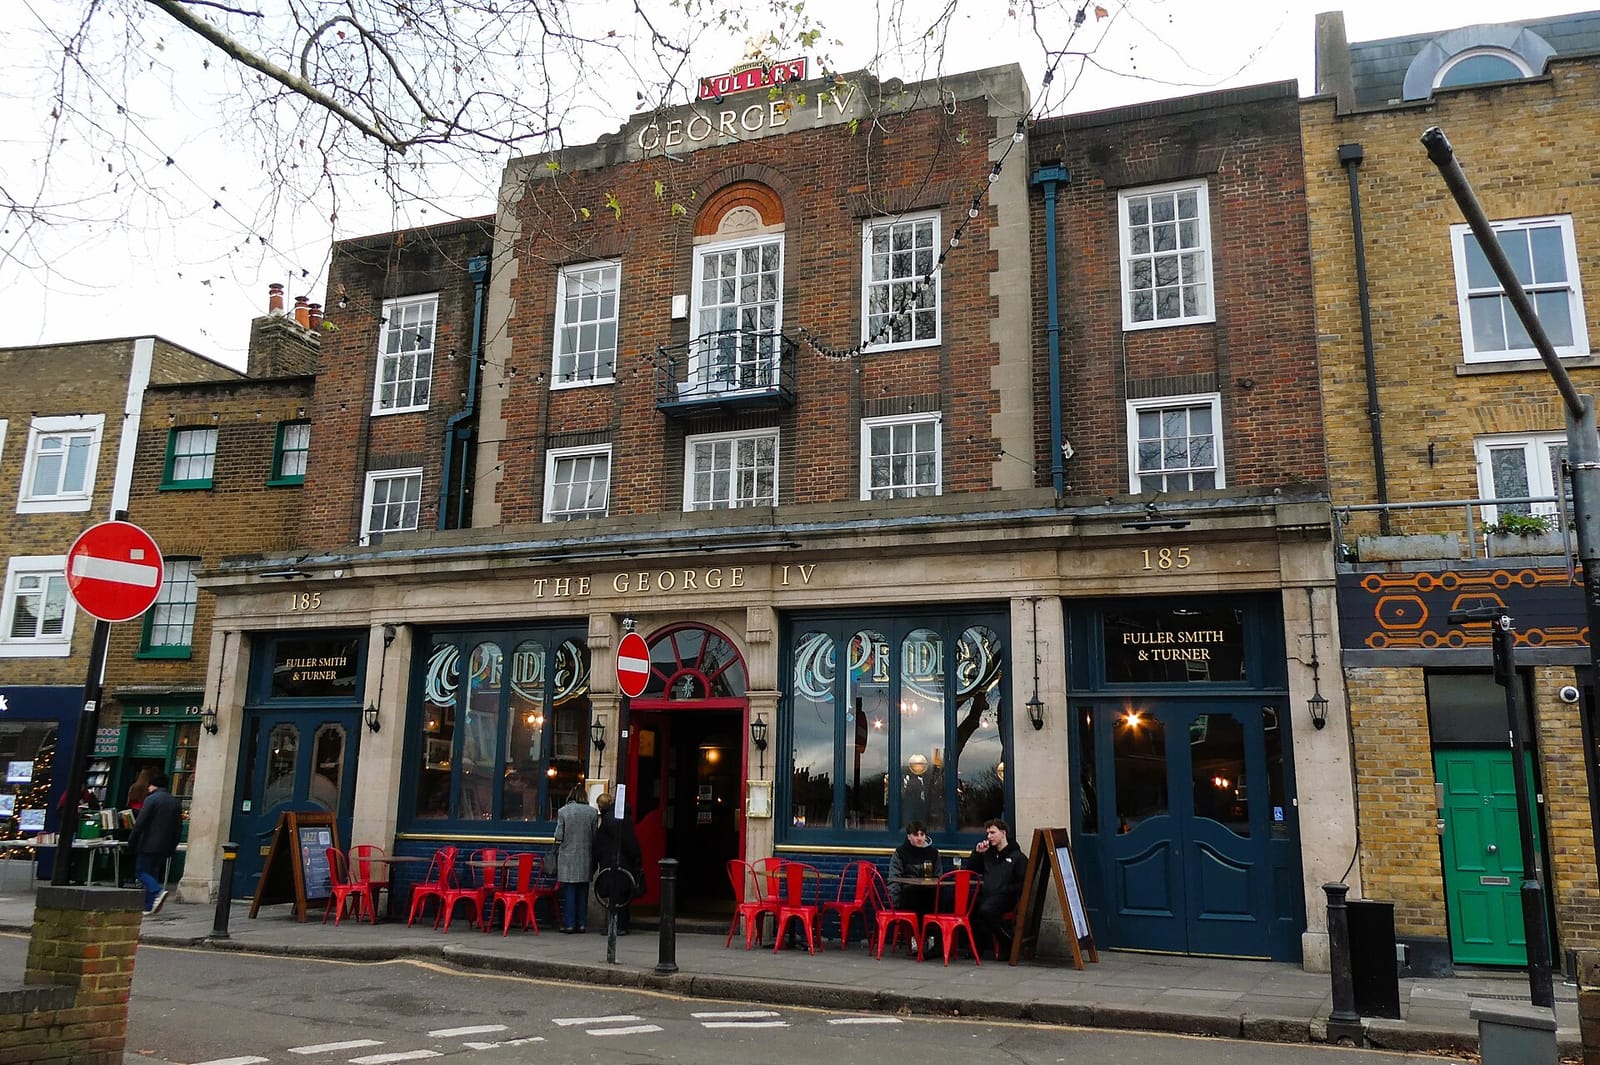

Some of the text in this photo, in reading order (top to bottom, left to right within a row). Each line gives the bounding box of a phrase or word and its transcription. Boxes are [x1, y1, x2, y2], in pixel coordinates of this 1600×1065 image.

[638, 100, 787, 150] GEORGE
[1141, 547, 1191, 570] 185
[534, 564, 817, 597] THE GEORGE IV
[291, 592, 322, 610] 185
[1123, 630, 1224, 644] FULLER SMITH
[1138, 648, 1211, 661] & TURNER
[286, 656, 347, 668] FULLER SMITH
[292, 671, 337, 680] & TURNER
[139, 706, 160, 715] 183
